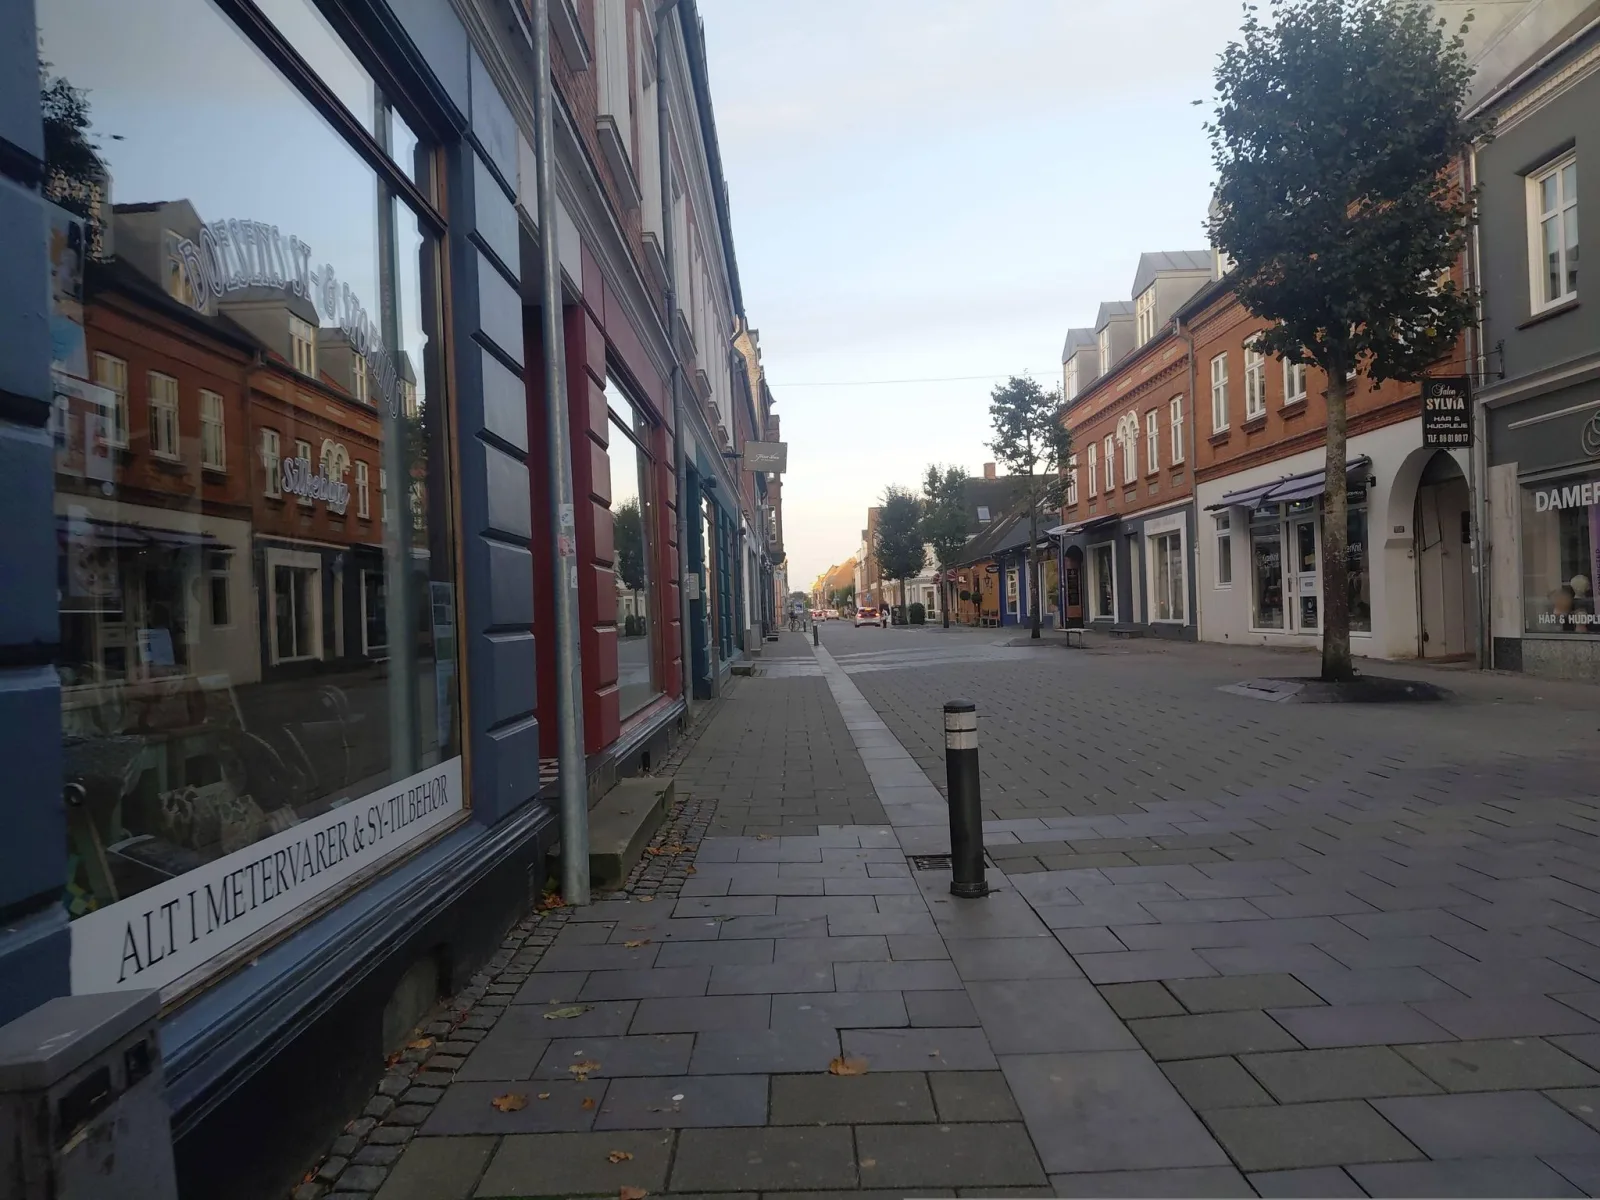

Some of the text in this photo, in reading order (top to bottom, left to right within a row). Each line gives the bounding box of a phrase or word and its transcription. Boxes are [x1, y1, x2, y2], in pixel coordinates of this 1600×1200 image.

[1426, 398, 1465, 410] SYLVIA
[1433, 414, 1451, 422] HÅR
[1427, 434, 1439, 443] TLF.
[1538, 611, 1556, 625] HÅR
[1559, 613, 1566, 624] &
[116, 773, 450, 984] ALT I METERVARER & SY-TILBEHØR
